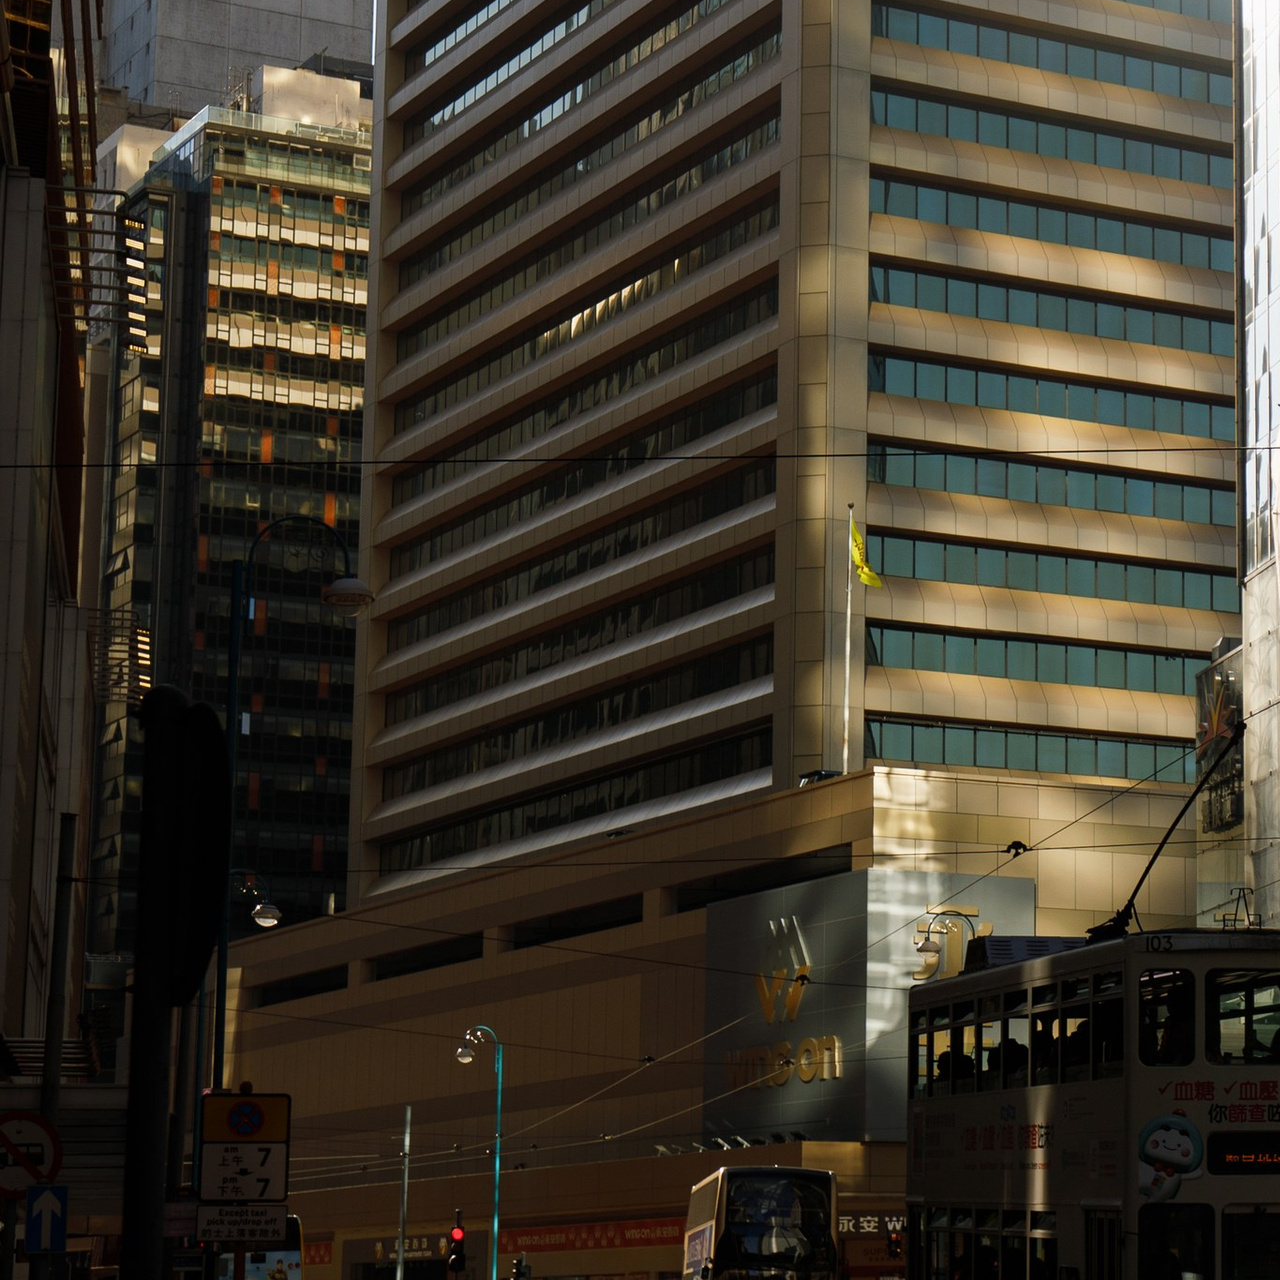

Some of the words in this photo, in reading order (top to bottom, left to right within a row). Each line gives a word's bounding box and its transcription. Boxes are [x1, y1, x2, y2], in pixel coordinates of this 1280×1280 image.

[1145, 935, 1173, 952] 103
[1173, 1081, 1215, 1101] 血糖
[1238, 1081, 1278, 1101] 血壓
[218, 1156, 244, 1167] 上午
[258, 1148, 271, 1167] 7
[217, 1186, 243, 1197] 下午
[256, 1178, 270, 1197] 7
[219, 1209, 249, 1219] Except
[251, 1209, 267, 1217] taxi
[207, 1218, 225, 1226] pick
[227, 1218, 262, 1227] up/drop
[264, 1218, 277, 1226] off
[201, 1228, 281, 1238] 的士上落客除外
